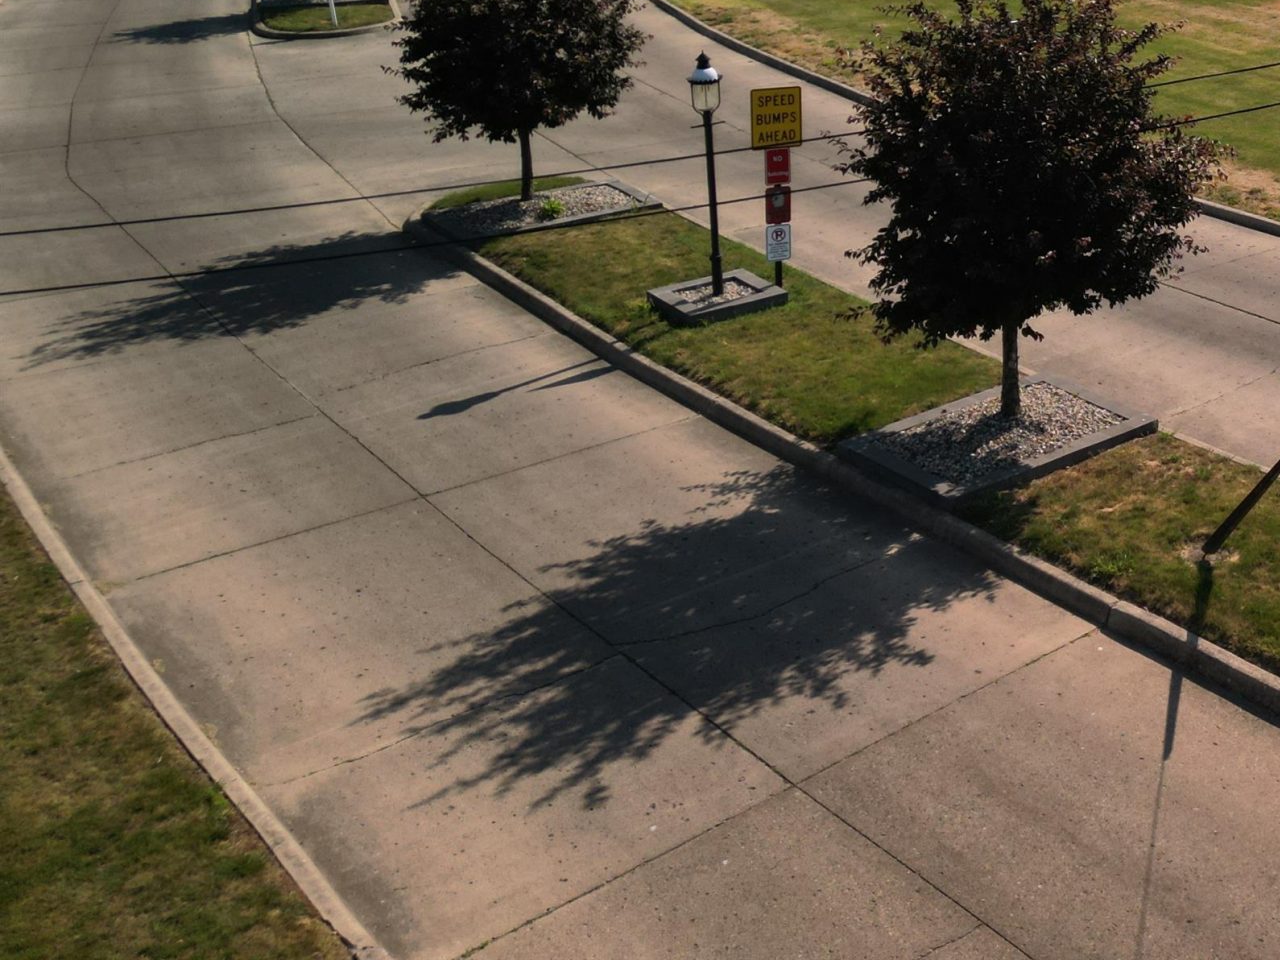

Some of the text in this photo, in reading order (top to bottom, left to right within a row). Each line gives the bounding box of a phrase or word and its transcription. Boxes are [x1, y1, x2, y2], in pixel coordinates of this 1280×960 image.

[758, 94, 795, 107] SPEED
[756, 111, 797, 126] BUMPS
[758, 129, 796, 143] AHEAD
